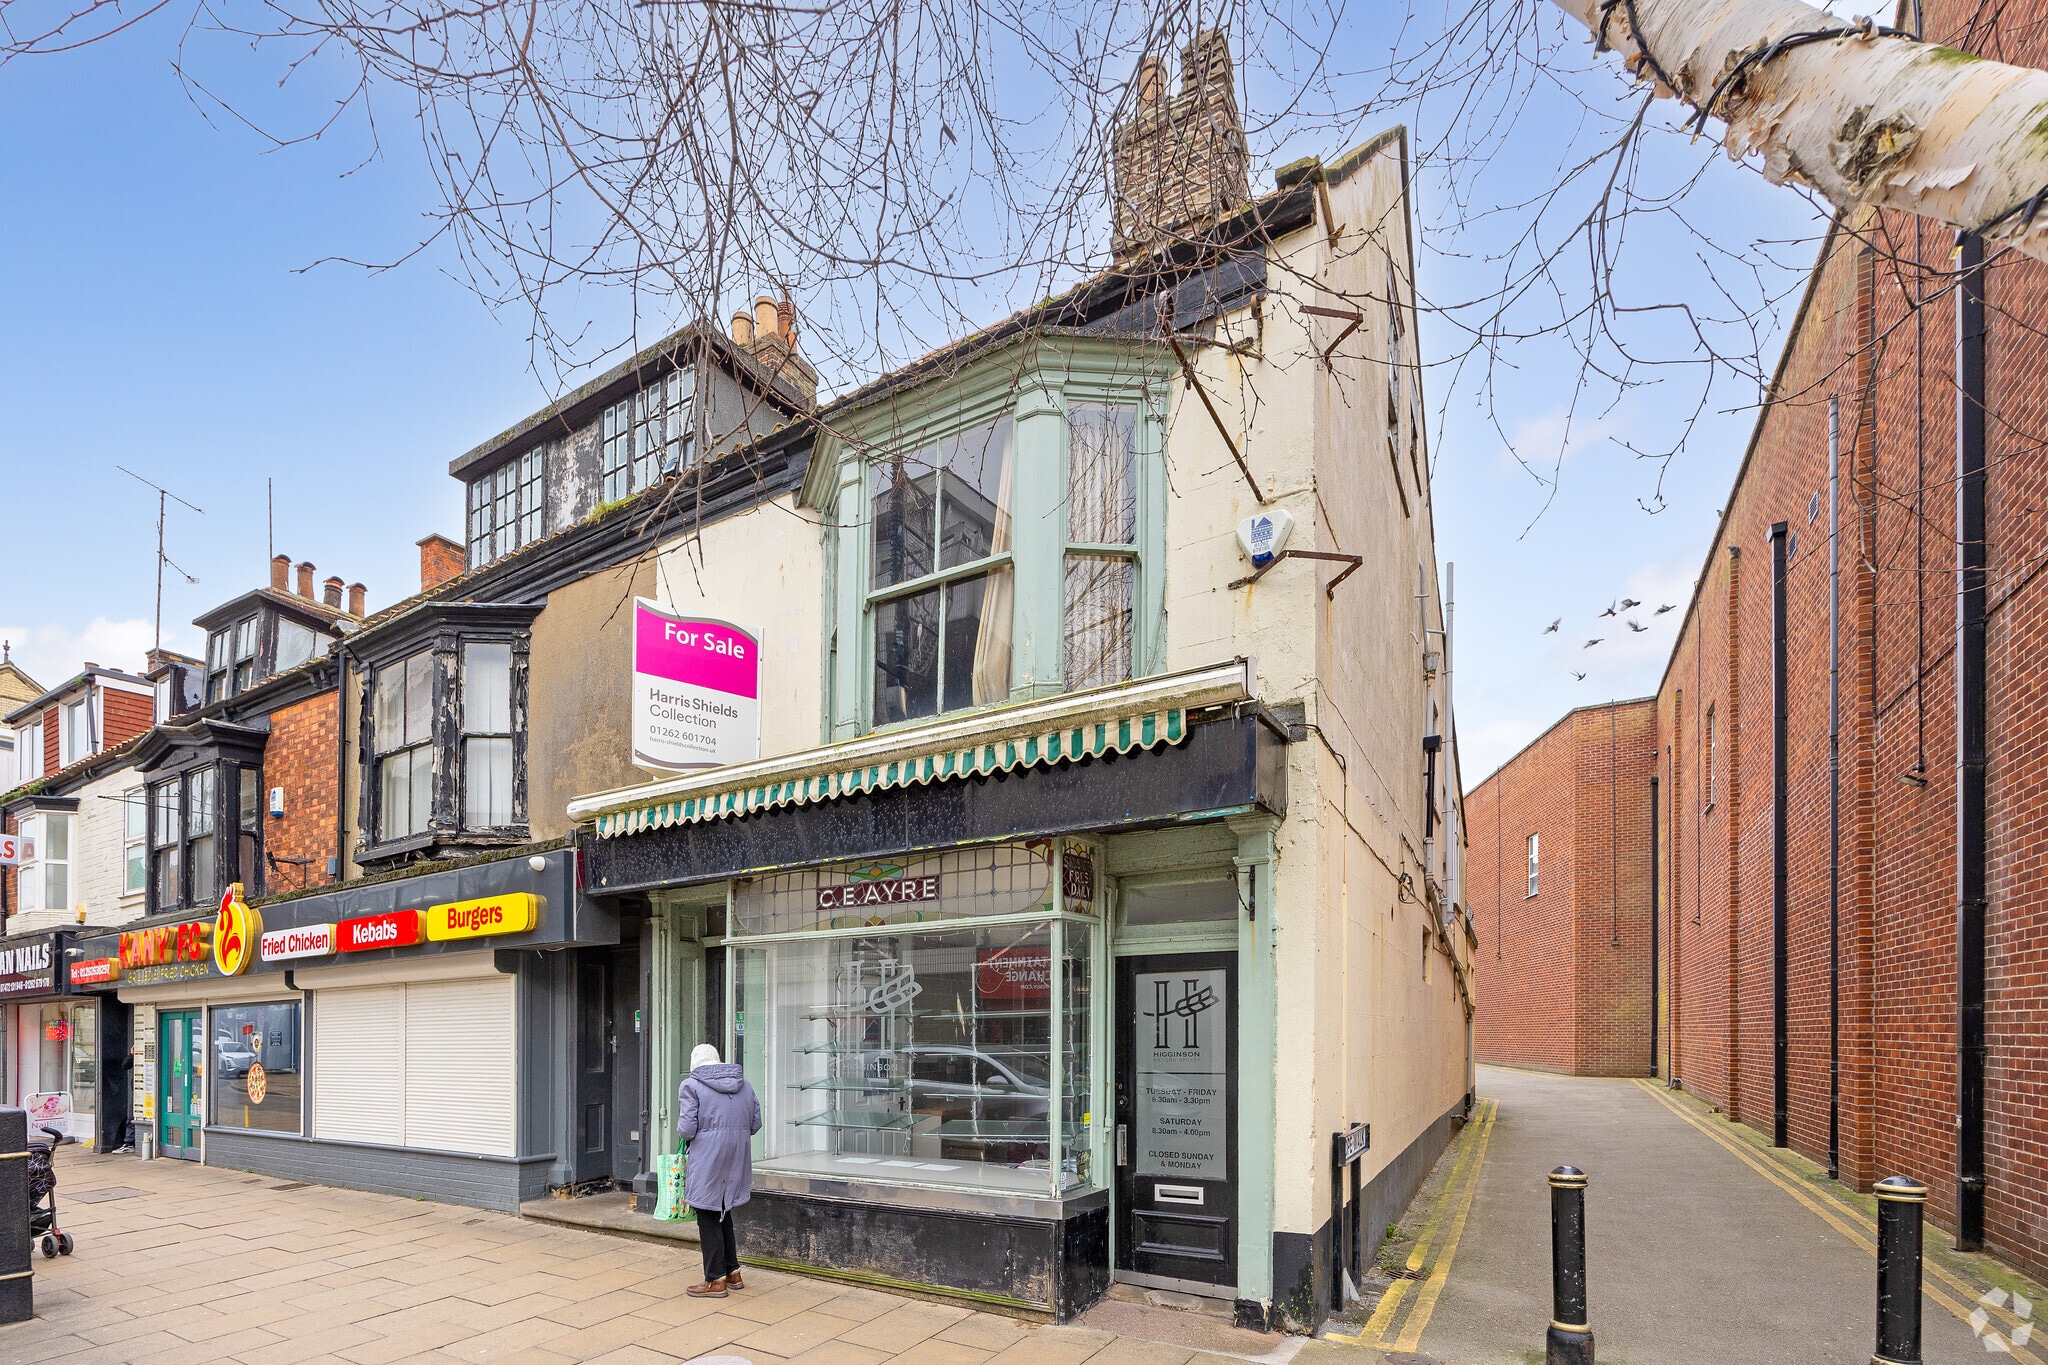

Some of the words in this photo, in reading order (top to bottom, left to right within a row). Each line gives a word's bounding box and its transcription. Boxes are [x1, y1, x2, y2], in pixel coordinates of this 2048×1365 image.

[664, 621, 699, 647] For
[703, 632, 745, 659] Sale
[649, 687, 691, 708] Harris
[692, 698, 738, 719] Shields
[649, 704, 717, 729] Collection
[650, 725, 680, 739] 01262
[682, 731, 717, 746] 601704
[447, 904, 503, 932] Burgers
[352, 919, 398, 945] Kebabs
[118, 925, 169, 969] KANY
[177, 921, 201, 962] FC
[262, 934, 286, 956] Fried
[288, 932, 328, 953] Chicken
[15, 942, 50, 973] NAILS
[179, 963, 210, 978] CHICKEN
[1146, 1087, 1182, 1095] TUESDAY
[1188, 1088, 1217, 1096] FRIDAY
[1183, 1096, 1211, 1105] 3.30pm
[1151, 1127, 1178, 1135] 8.30am
[1183, 1128, 1211, 1137] 4.00pm
[1159, 1117, 1202, 1126] SATURDAY
[1148, 1150, 1180, 1159] CLOSED
[1181, 1152, 1215, 1161] SUNDAY
[1160, 1160, 1166, 1168] &
[1167, 1161, 1202, 1170] MONDAY
